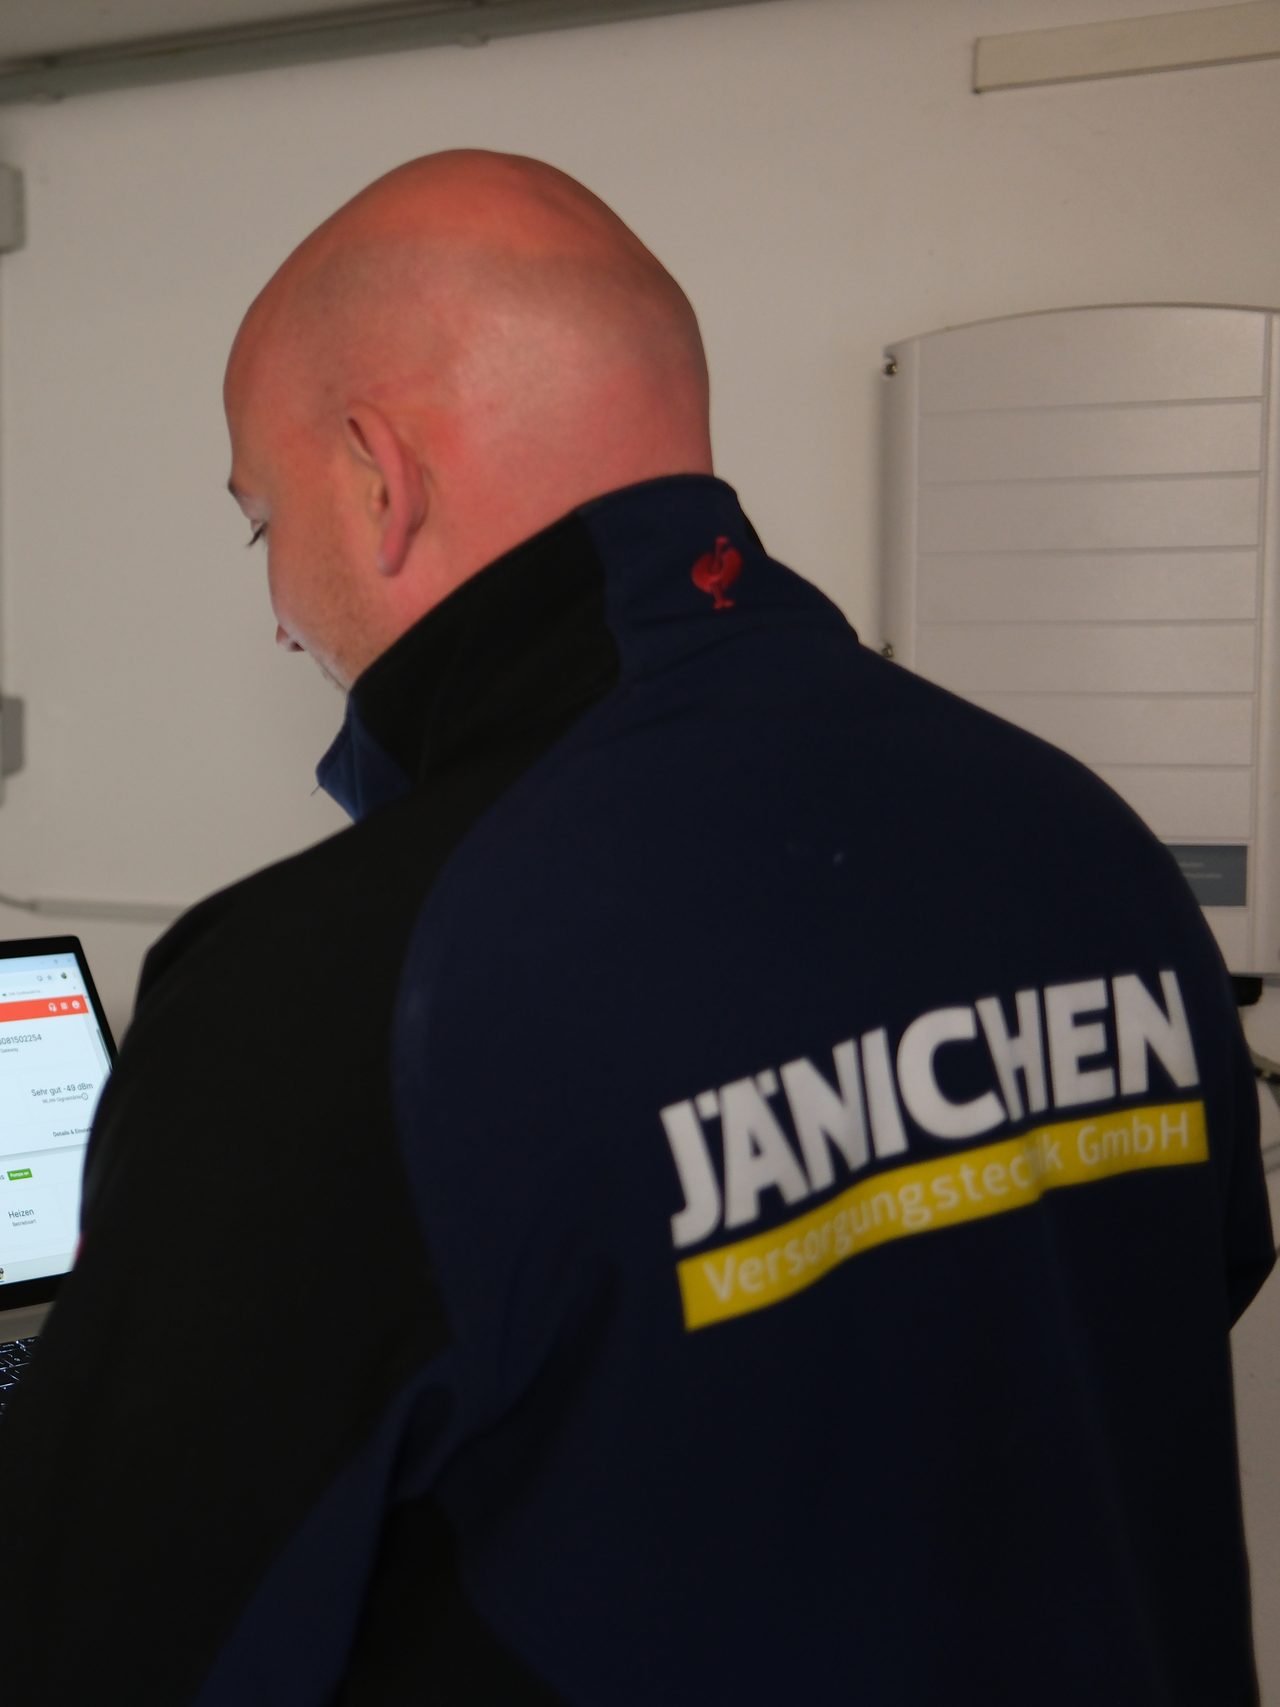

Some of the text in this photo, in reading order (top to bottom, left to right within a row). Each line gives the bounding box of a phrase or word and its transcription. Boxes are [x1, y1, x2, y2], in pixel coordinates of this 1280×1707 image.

[31, 1088, 48, 1097] Sehr
[49, 1086, 62, 1096] gut
[659, 969, 1203, 1250] JÄNICHEN
[1077, 1111, 1189, 1166] GmbH
[8, 1208, 35, 1219] Heizen
